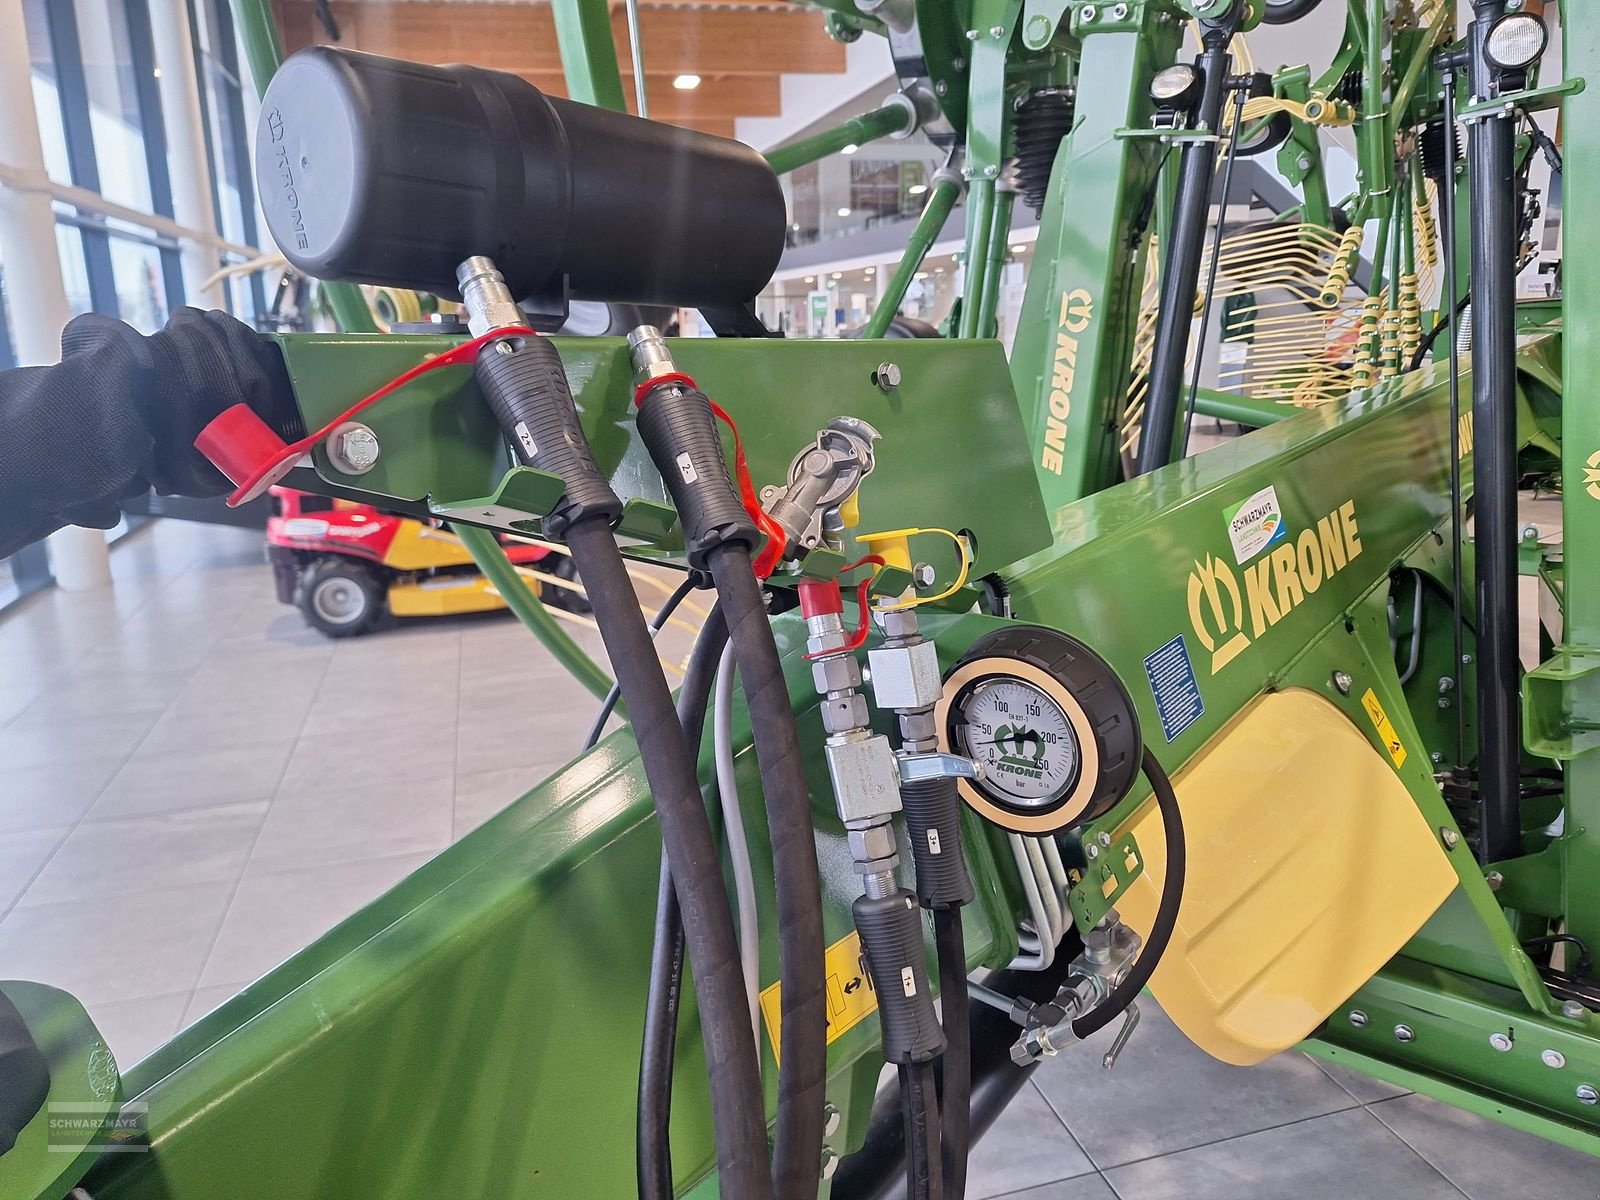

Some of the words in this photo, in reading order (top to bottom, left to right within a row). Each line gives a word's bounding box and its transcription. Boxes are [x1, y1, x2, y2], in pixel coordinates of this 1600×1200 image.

[276, 145, 309, 250] KRONE
[1041, 332, 1078, 476] KRONE
[520, 432, 531, 447] 2+
[682, 463, 691, 474] 2-
[1232, 502, 1273, 532] SCHWARZMAYR
[1243, 499, 1363, 640] KRONE
[994, 701, 1009, 713] 100
[1025, 704, 1041, 717] 150
[981, 723, 992, 735] 50
[1041, 731, 1057, 744] 200
[989, 747, 995, 758] 0
[996, 763, 1043, 780] KRONE
[1034, 759, 1049, 771] 250
[1015, 779, 1026, 788] bar
[929, 835, 937, 846] 3+
[903, 975, 911, 988] 1+
